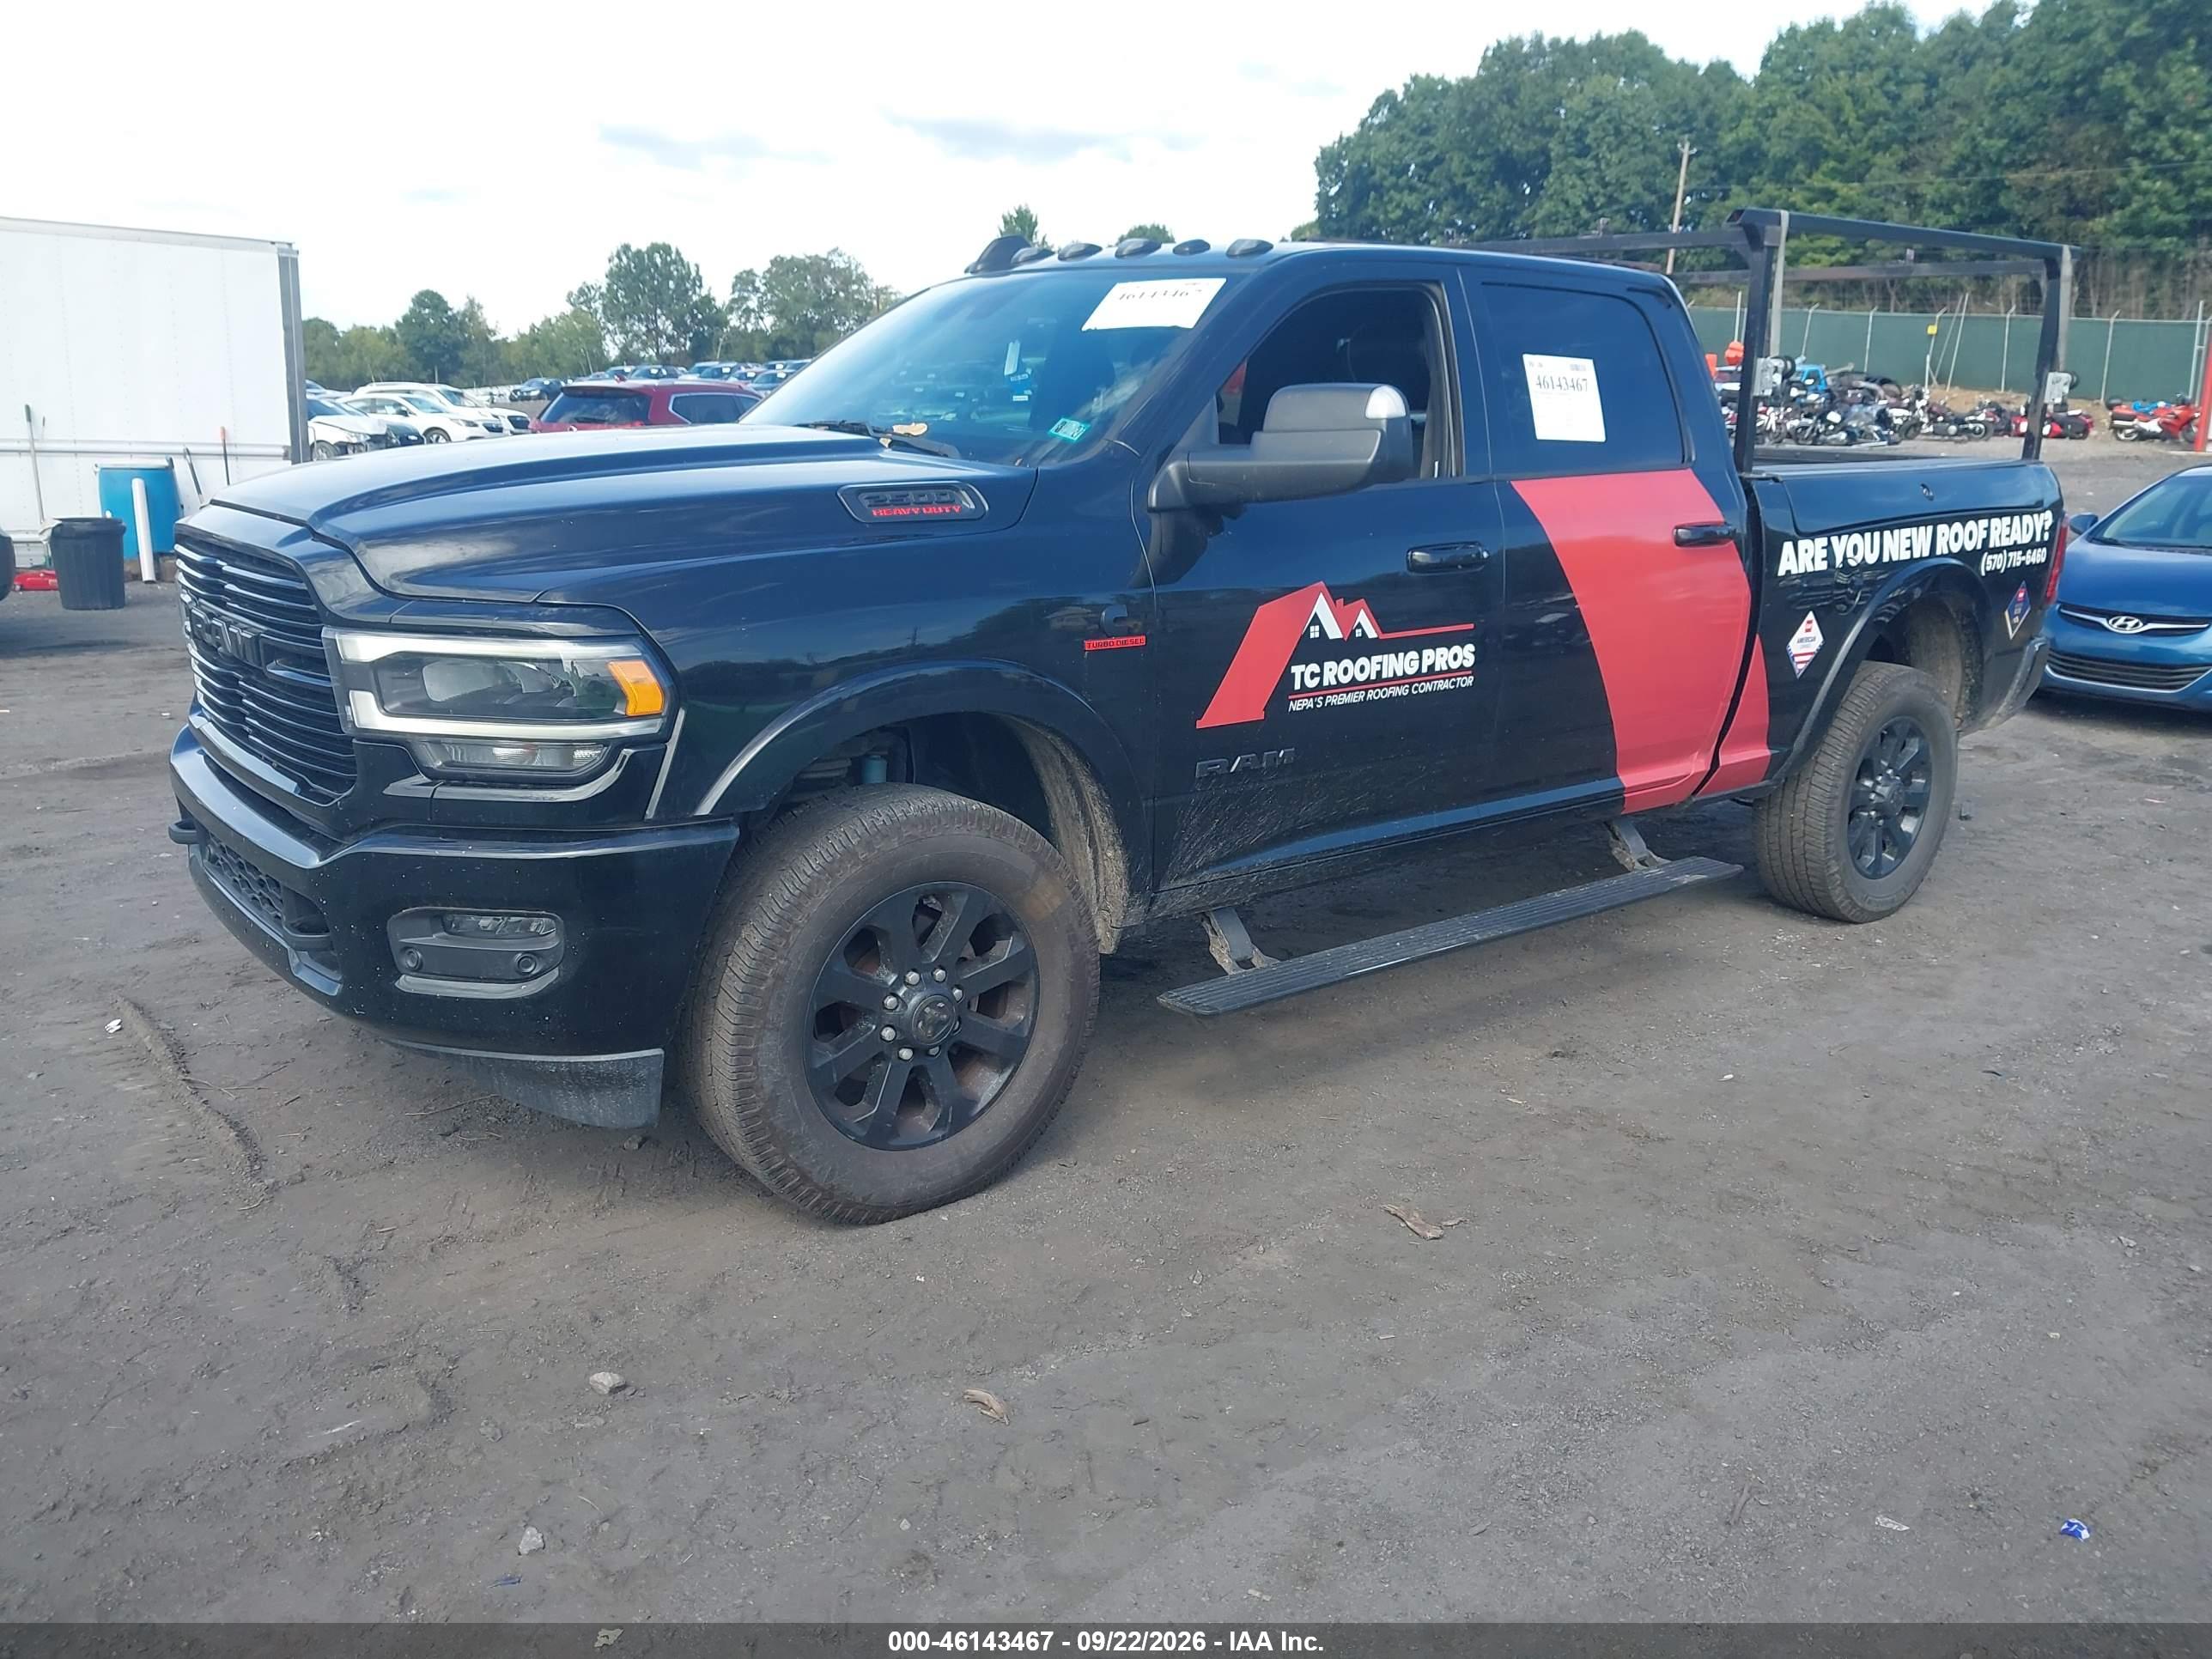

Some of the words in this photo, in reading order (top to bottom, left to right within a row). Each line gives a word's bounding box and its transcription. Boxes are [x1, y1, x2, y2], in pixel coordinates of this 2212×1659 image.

[1535, 374, 1588, 392] 46143467
[864, 491, 956, 507] 2500
[872, 507, 920, 516] HEAVY
[922, 505, 963, 514] DUTY
[1777, 537, 1828, 576] ARE
[1830, 531, 1881, 568] YOU
[1882, 525, 1933, 562] NEW
[1936, 519, 1989, 556] ROOF
[1989, 509, 2053, 548] READY?
[1980, 549, 2007, 576] (570)
[2007, 547, 2047, 568] 715-6460
[1086, 641, 1115, 649] TURBO
[1116, 637, 1145, 646] DIESEL
[1291, 663, 1321, 690] TC
[1322, 650, 1420, 686] ROOFING
[1421, 643, 1475, 673] PROS
[1288, 696, 1323, 714] NEPA'S
[1325, 690, 1365, 707] PREMIER
[1366, 684, 1409, 700] ROOFING
[1412, 676, 1474, 695] CONTRACTOR
[1196, 748, 1295, 778] RAM
